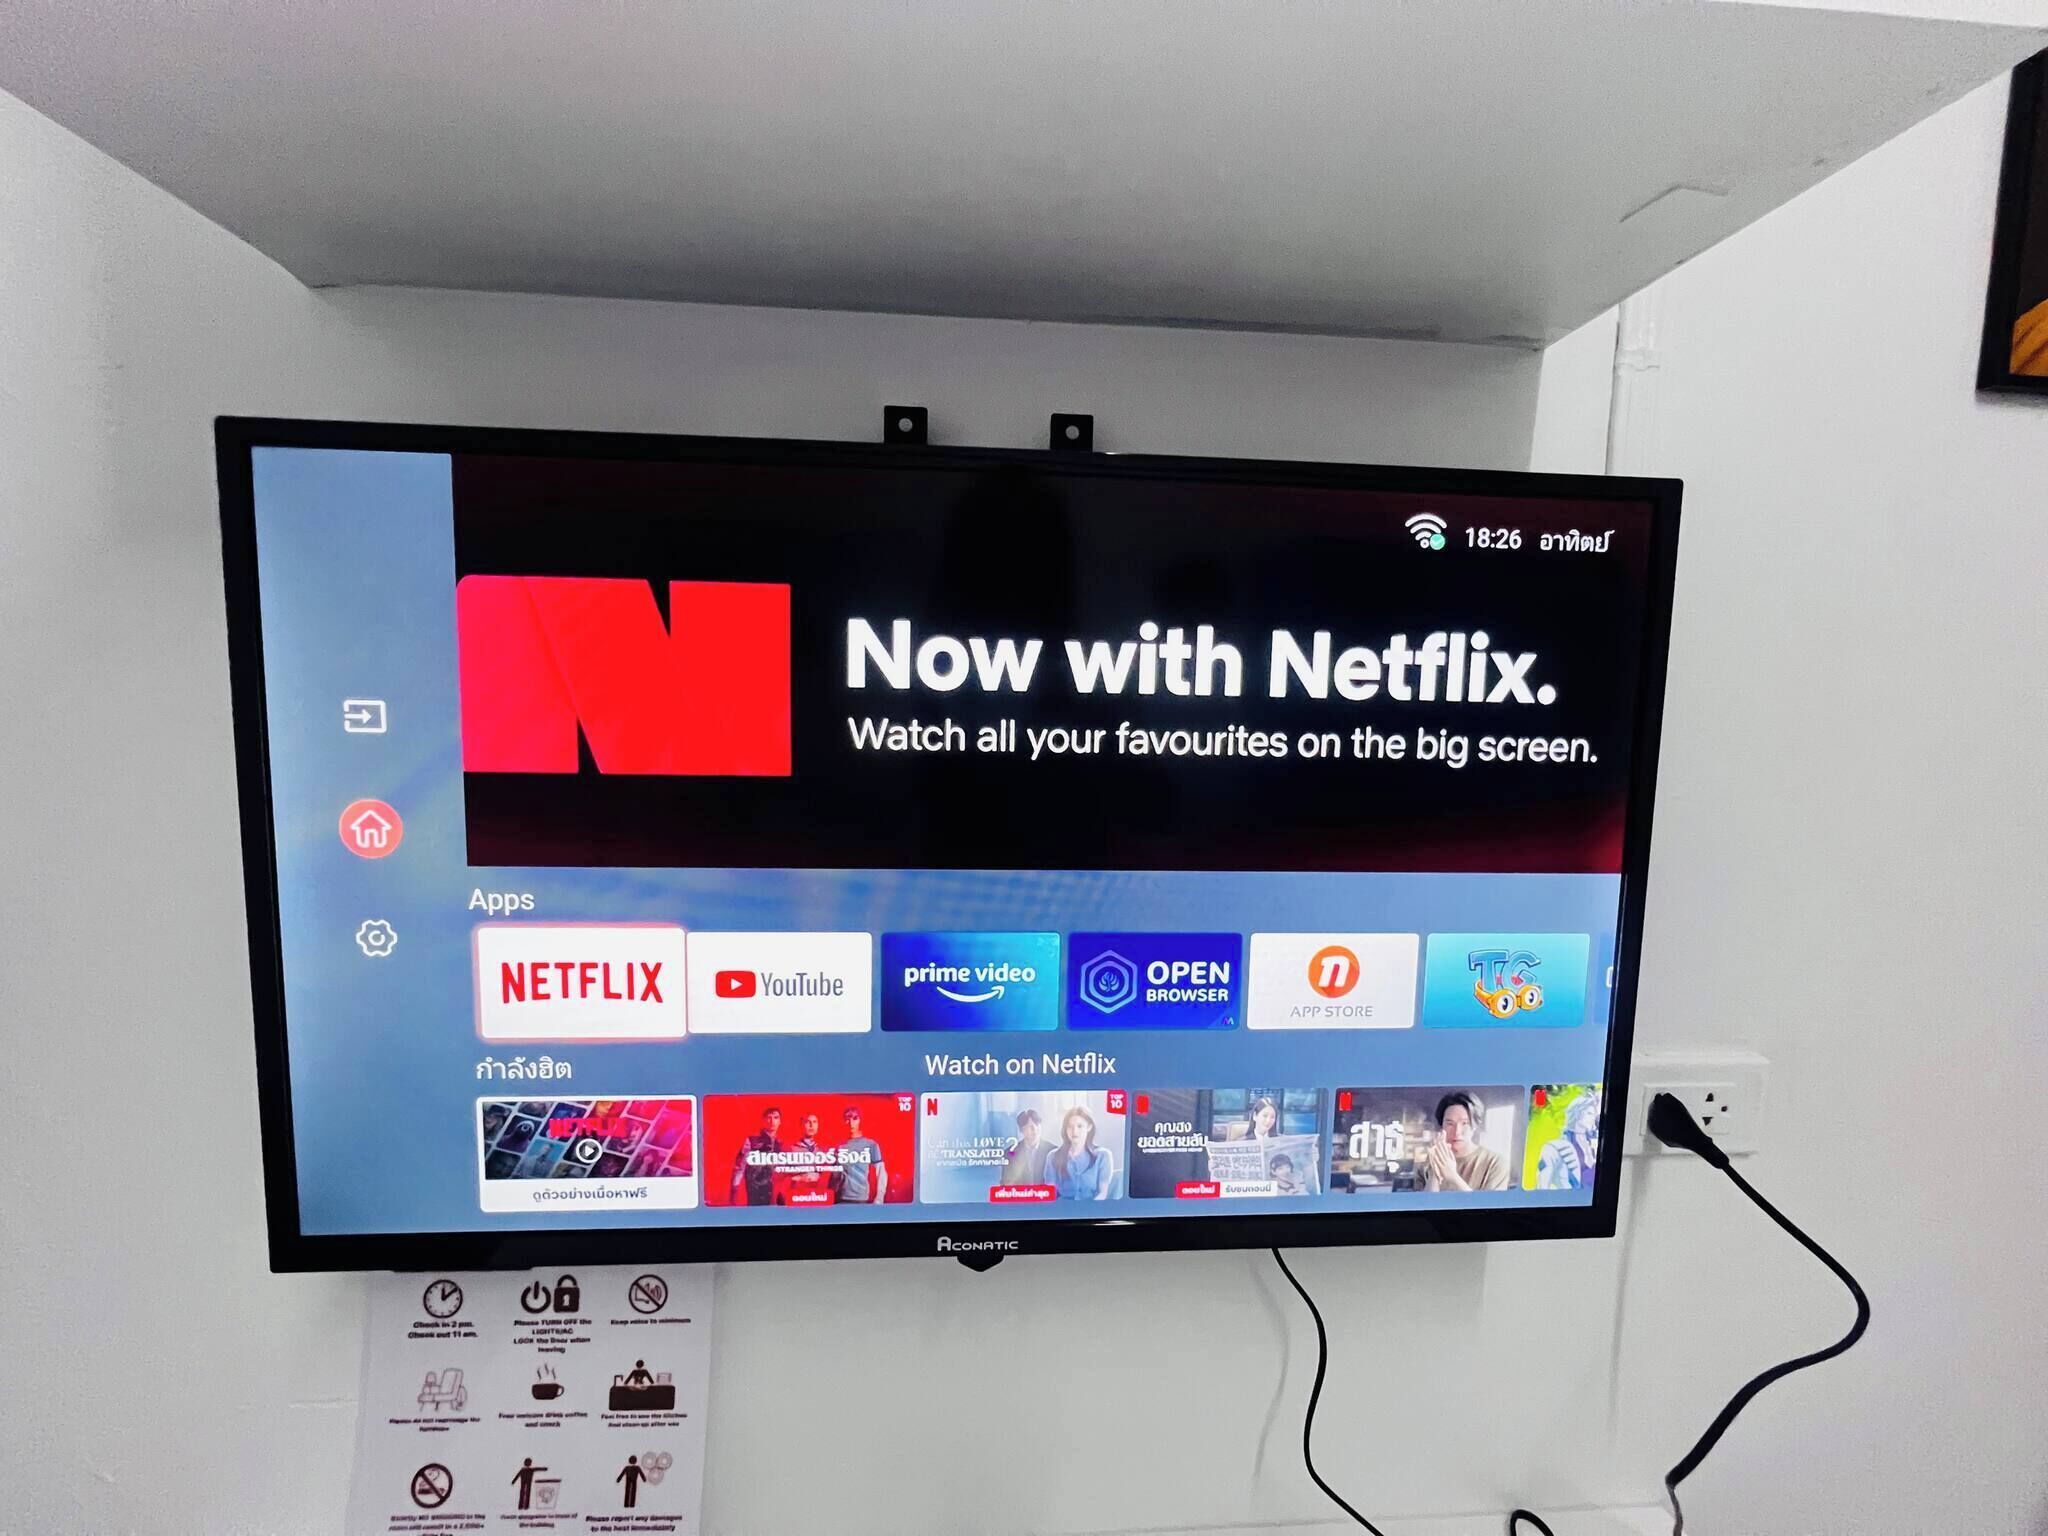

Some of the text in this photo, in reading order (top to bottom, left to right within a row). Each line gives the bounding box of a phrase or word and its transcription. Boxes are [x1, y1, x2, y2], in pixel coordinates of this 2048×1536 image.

[1466, 527, 1522, 549] 18:26
[1540, 528, 1615, 553] อาทิตย์
[847, 618, 1557, 705] Now with Netflix.
[847, 717, 1598, 769] Watch all your favourites on the big screen.
[468, 889, 535, 915] Apps
[501, 962, 664, 1004] NETFLIX
[760, 972, 844, 997] YouTube
[904, 962, 1036, 987] prime video
[1146, 960, 1230, 985] OPEN
[1146, 988, 1229, 1002] BROWSER
[1290, 1006, 1373, 1018] APP STORE
[476, 1056, 572, 1080] กำลังฮิต
[925, 1052, 1117, 1076] Watch on Netflix
[899, 1103, 911, 1112] 10
[1110, 1099, 1122, 1109] 10
